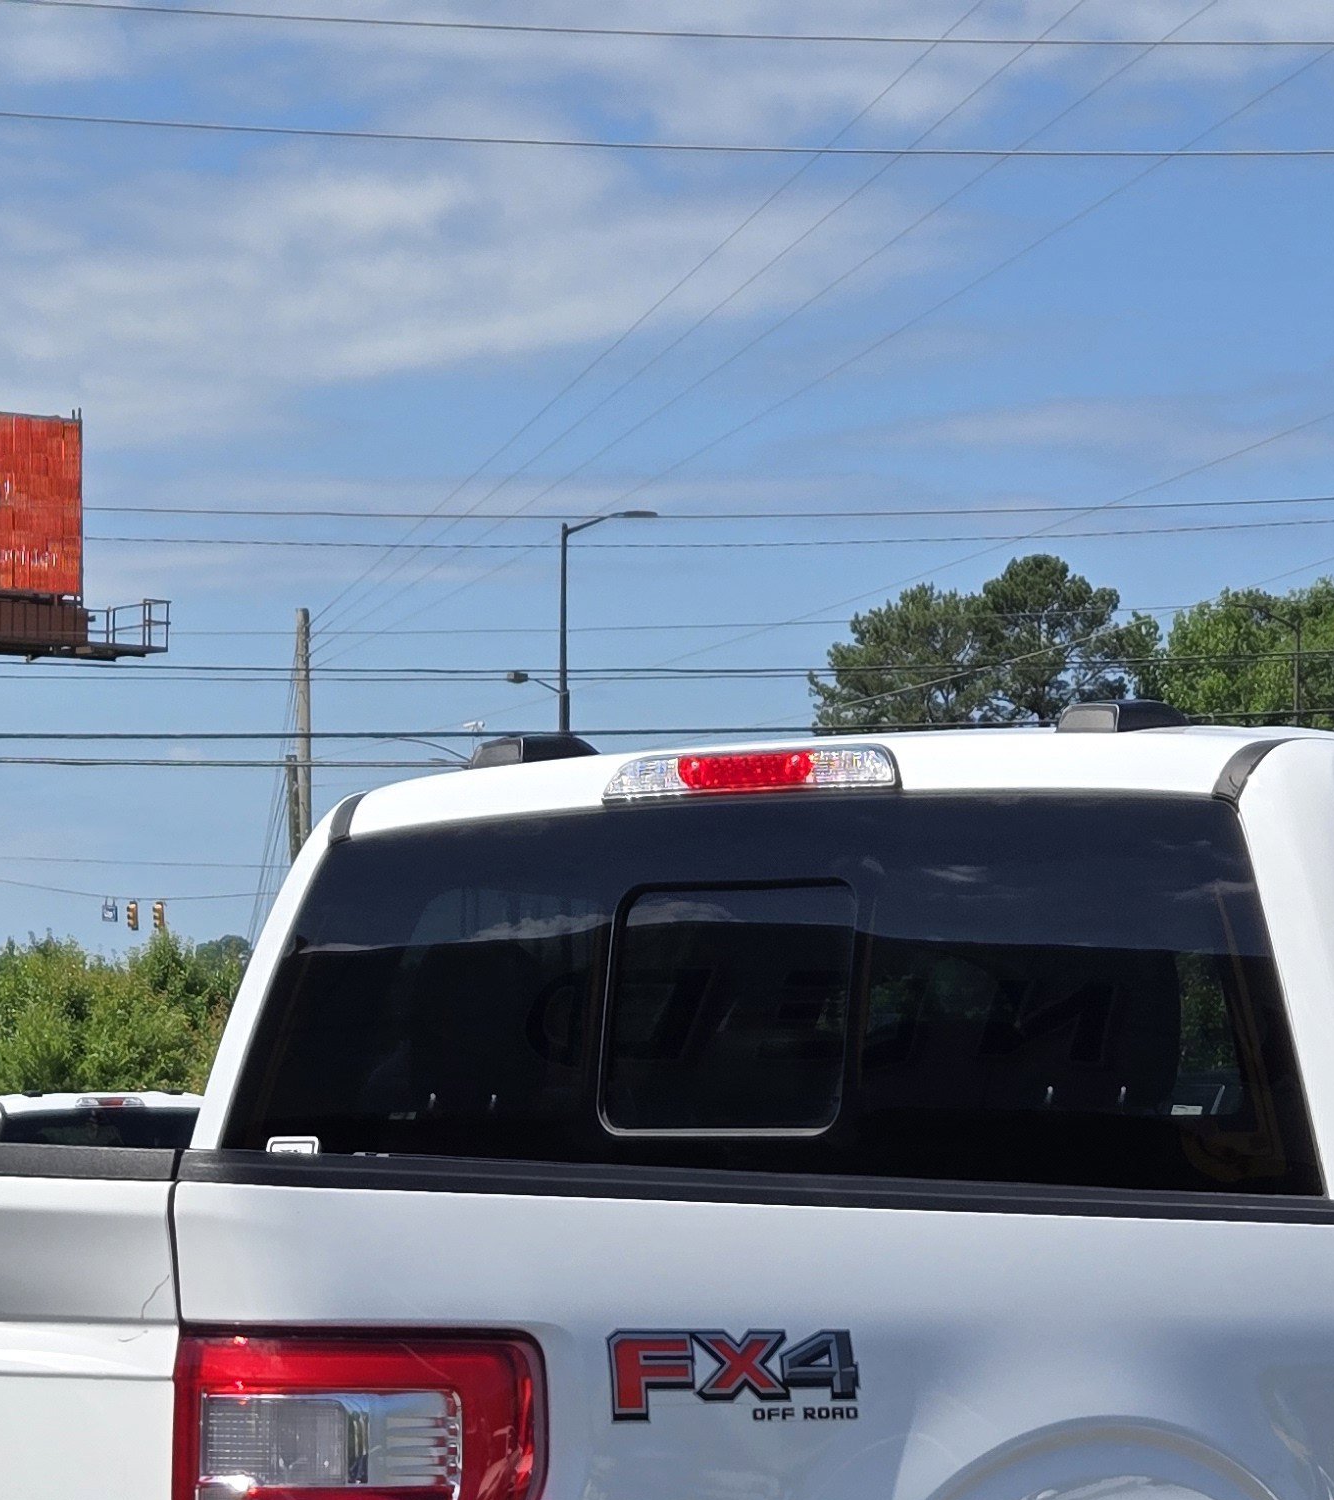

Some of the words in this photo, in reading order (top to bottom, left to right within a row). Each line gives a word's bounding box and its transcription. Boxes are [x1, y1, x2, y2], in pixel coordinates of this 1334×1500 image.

[606, 1328, 861, 1424] FX4
[752, 1407, 795, 1421] OFF
[803, 1406, 859, 1421] ROAD
